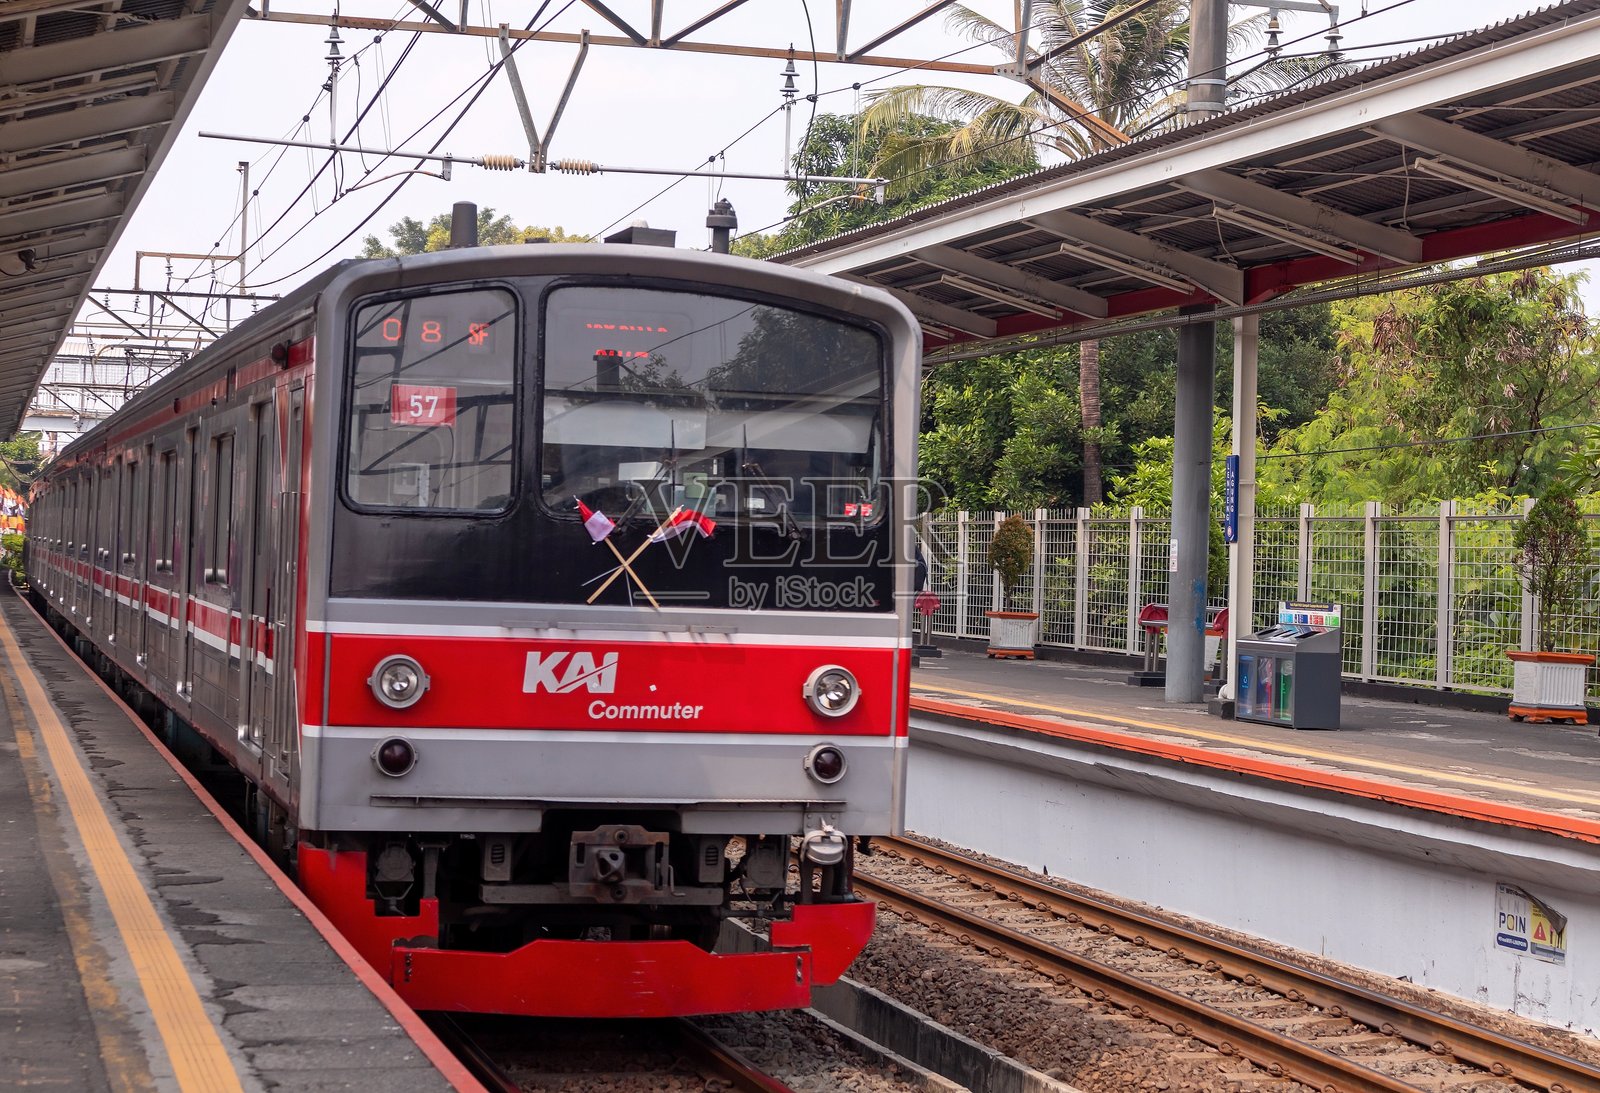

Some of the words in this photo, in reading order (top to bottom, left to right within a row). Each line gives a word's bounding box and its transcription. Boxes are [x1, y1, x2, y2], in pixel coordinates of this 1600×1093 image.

[410, 395, 439, 418] 57
[522, 651, 619, 694] KAI
[588, 700, 703, 719] Commuter
[1499, 911, 1526, 934] POIN
